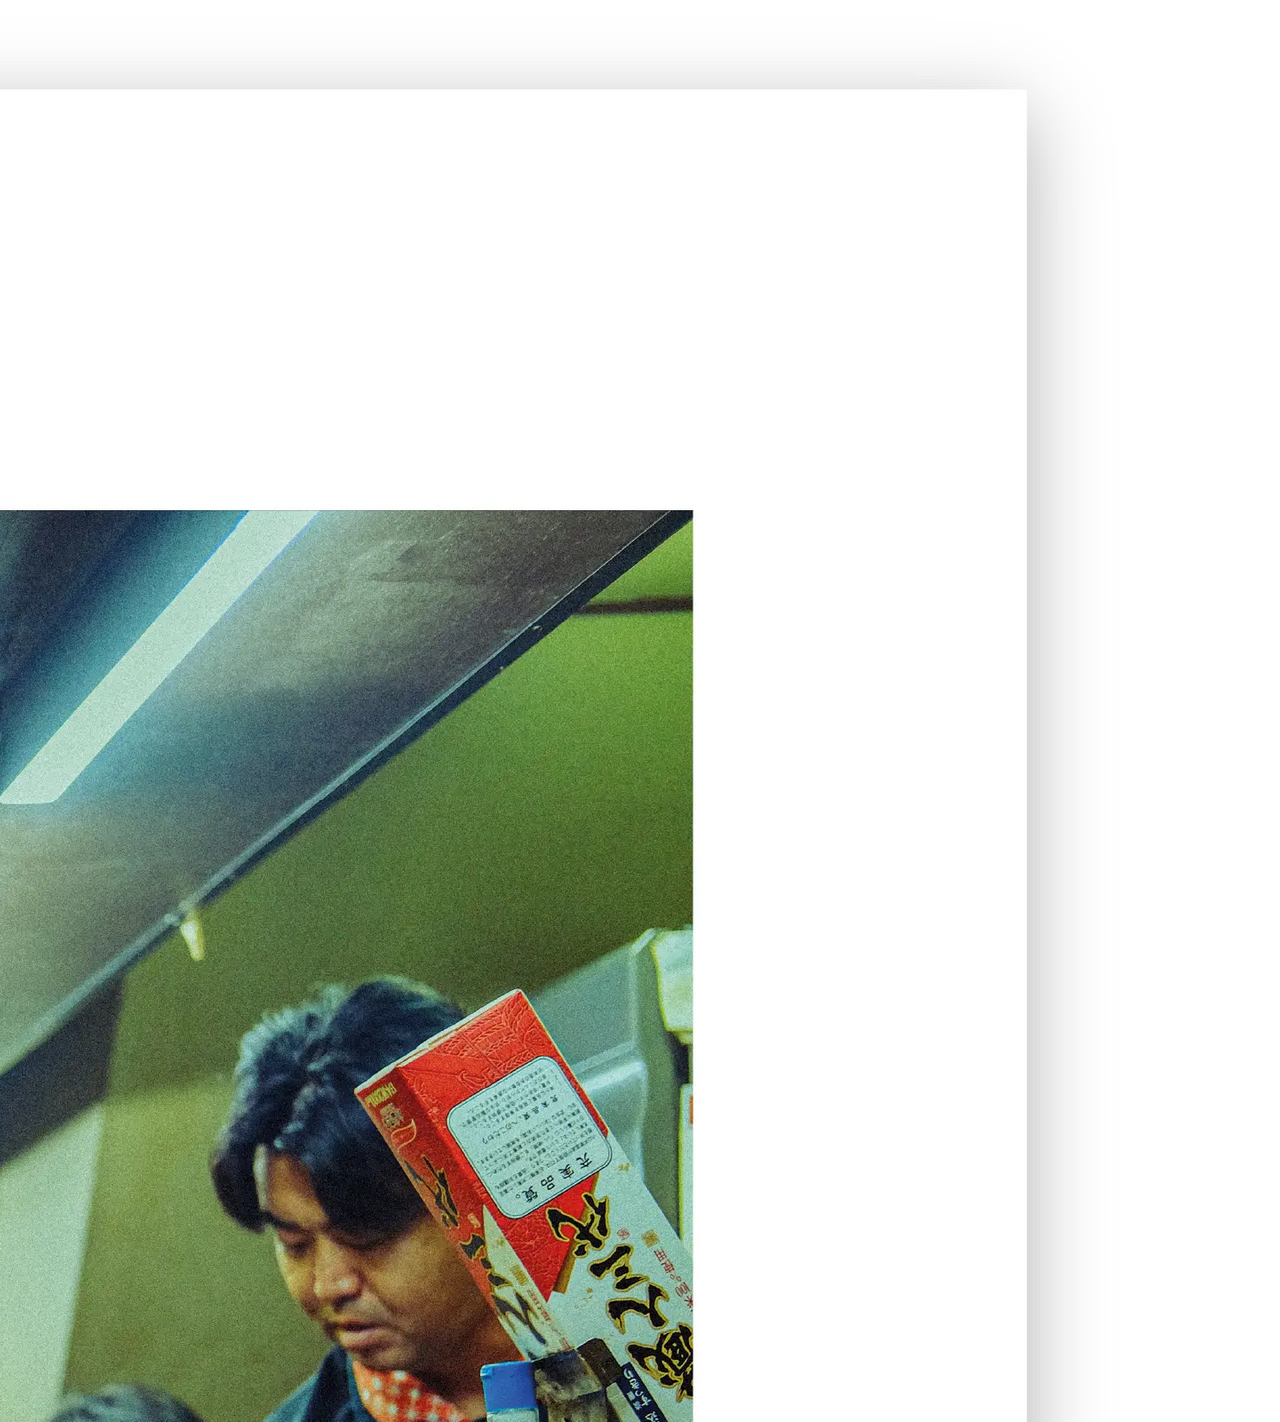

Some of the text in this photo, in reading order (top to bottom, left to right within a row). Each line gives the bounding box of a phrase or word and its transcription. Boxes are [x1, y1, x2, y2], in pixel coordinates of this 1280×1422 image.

[513, 1151, 593, 1204] 充実品質。
[652, 1245, 693, 1311] 米100%使用
[624, 1367, 652, 1407] すっきり
